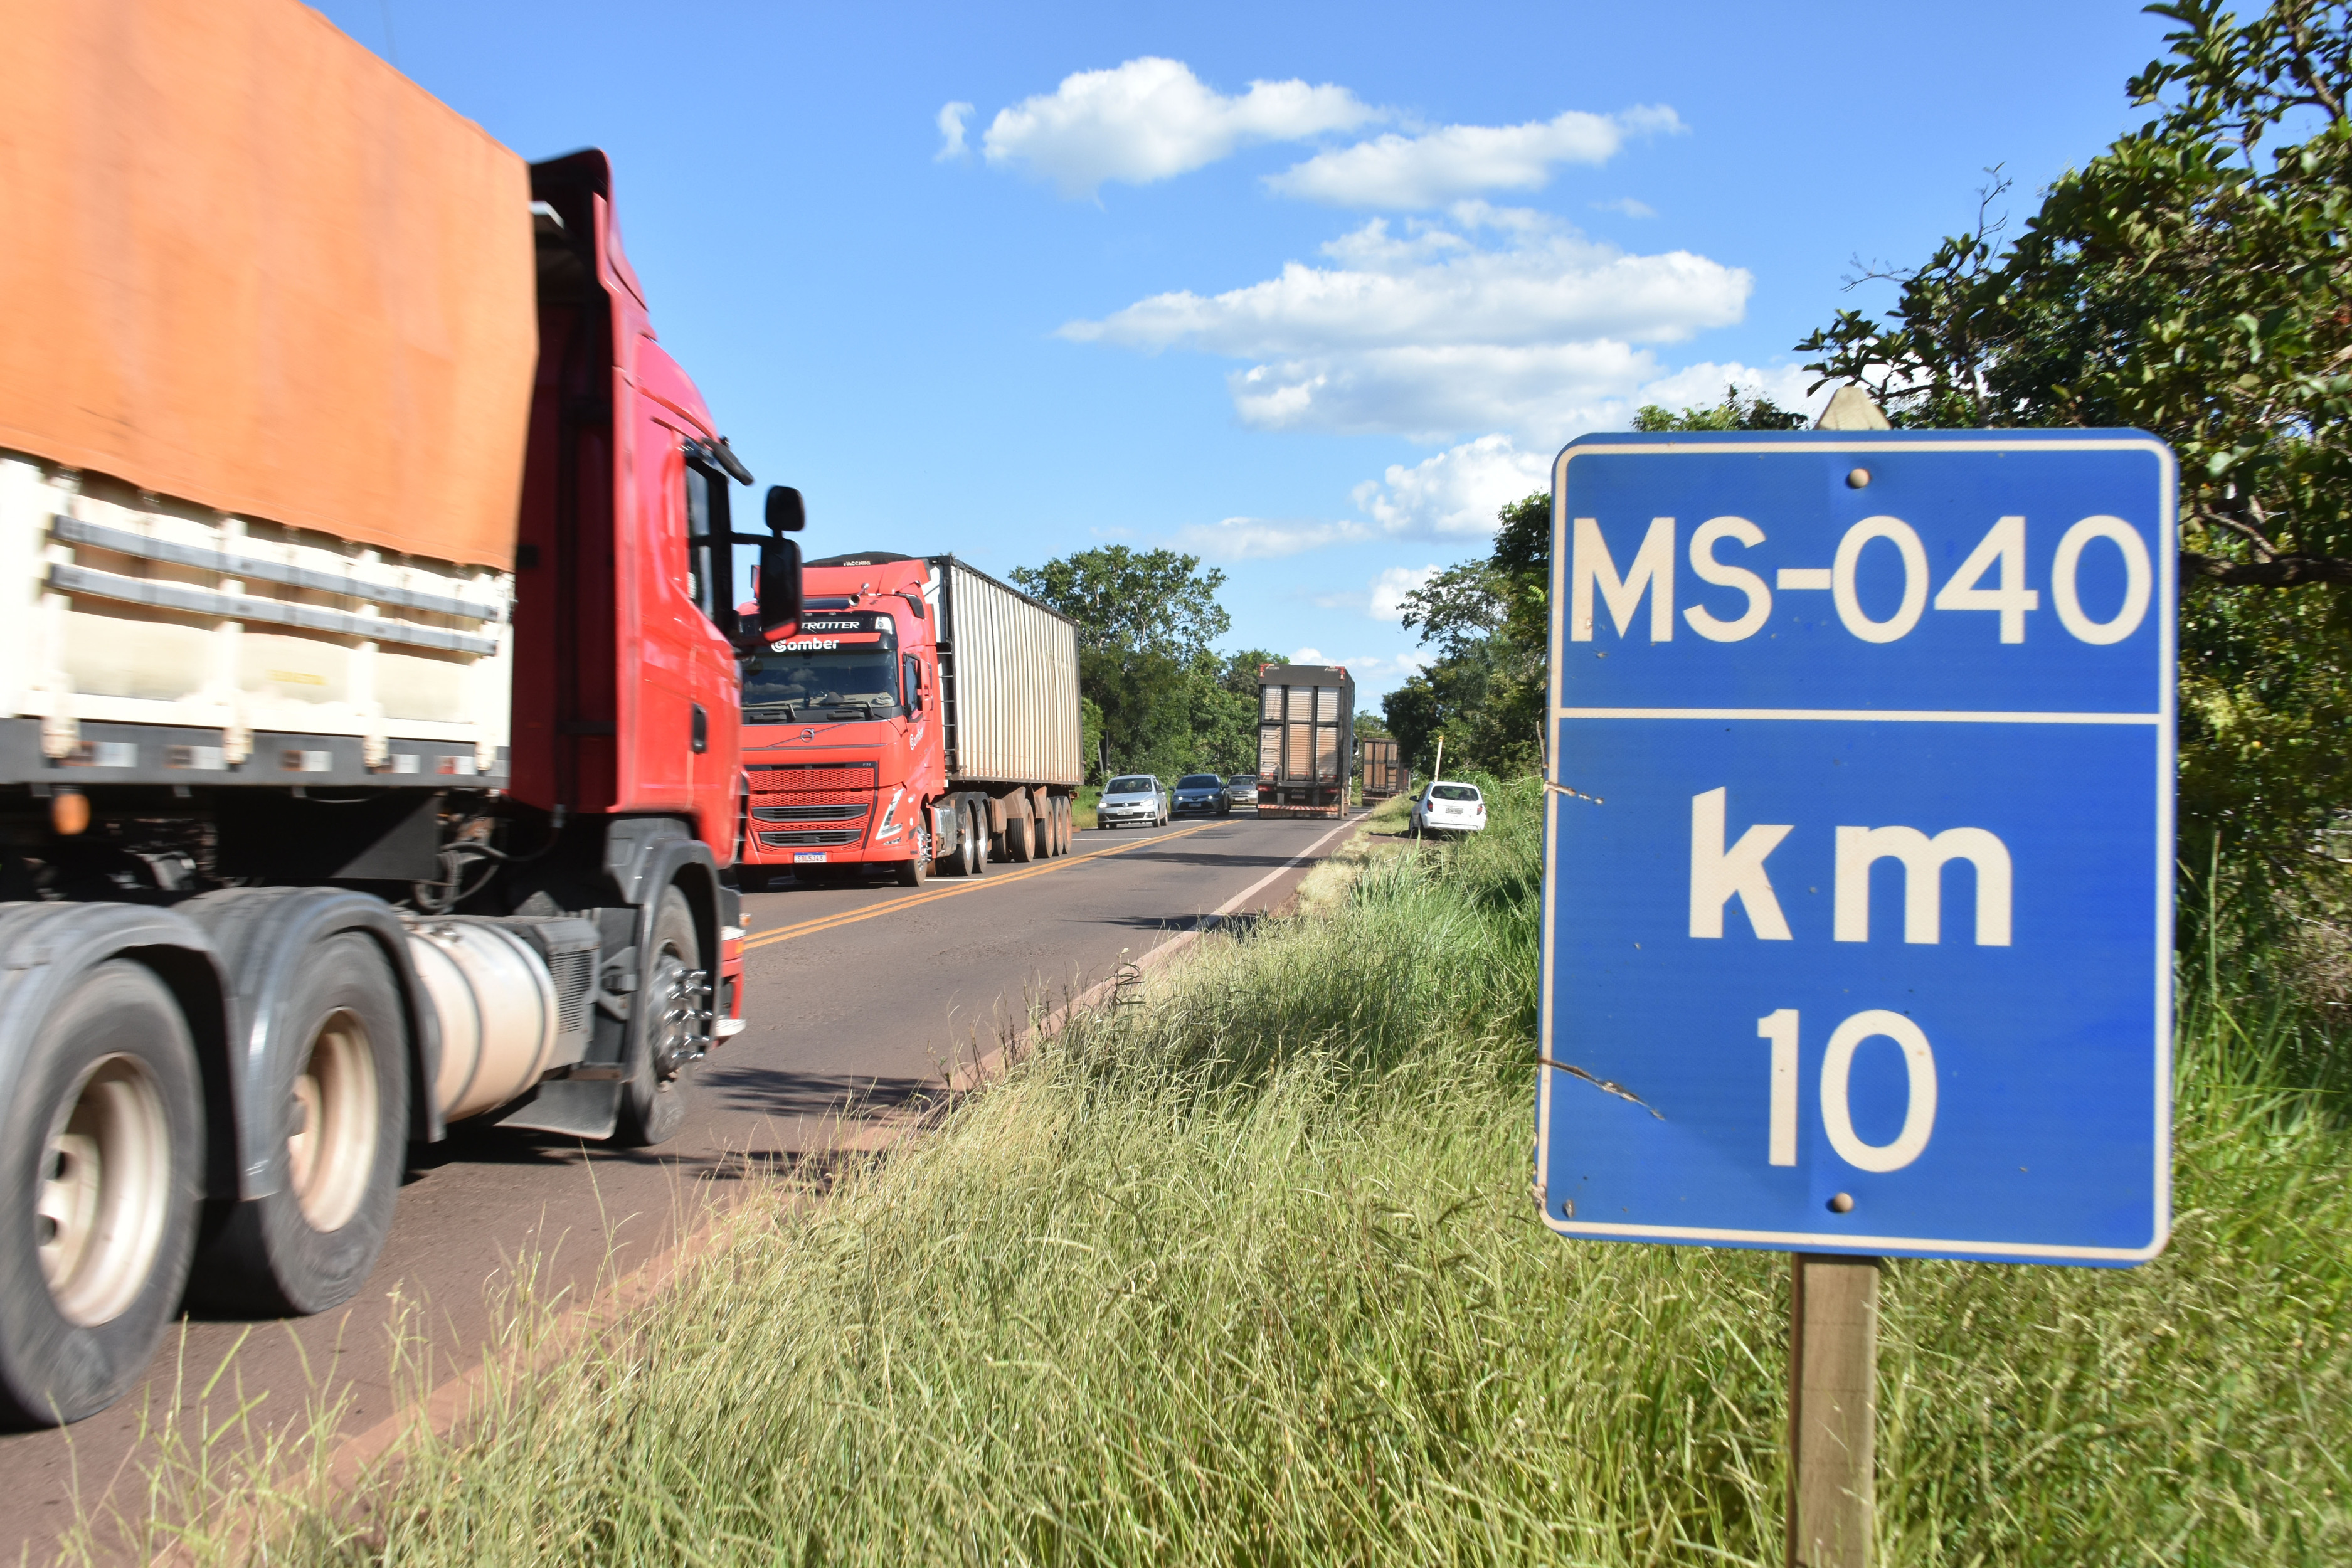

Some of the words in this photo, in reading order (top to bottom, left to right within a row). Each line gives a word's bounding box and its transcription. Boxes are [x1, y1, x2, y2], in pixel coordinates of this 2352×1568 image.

[801, 621, 860, 633] TROTTER
[1571, 515, 2153, 645] MS-040
[1688, 786, 2013, 947] km
[1757, 1009, 1937, 1173] 10
